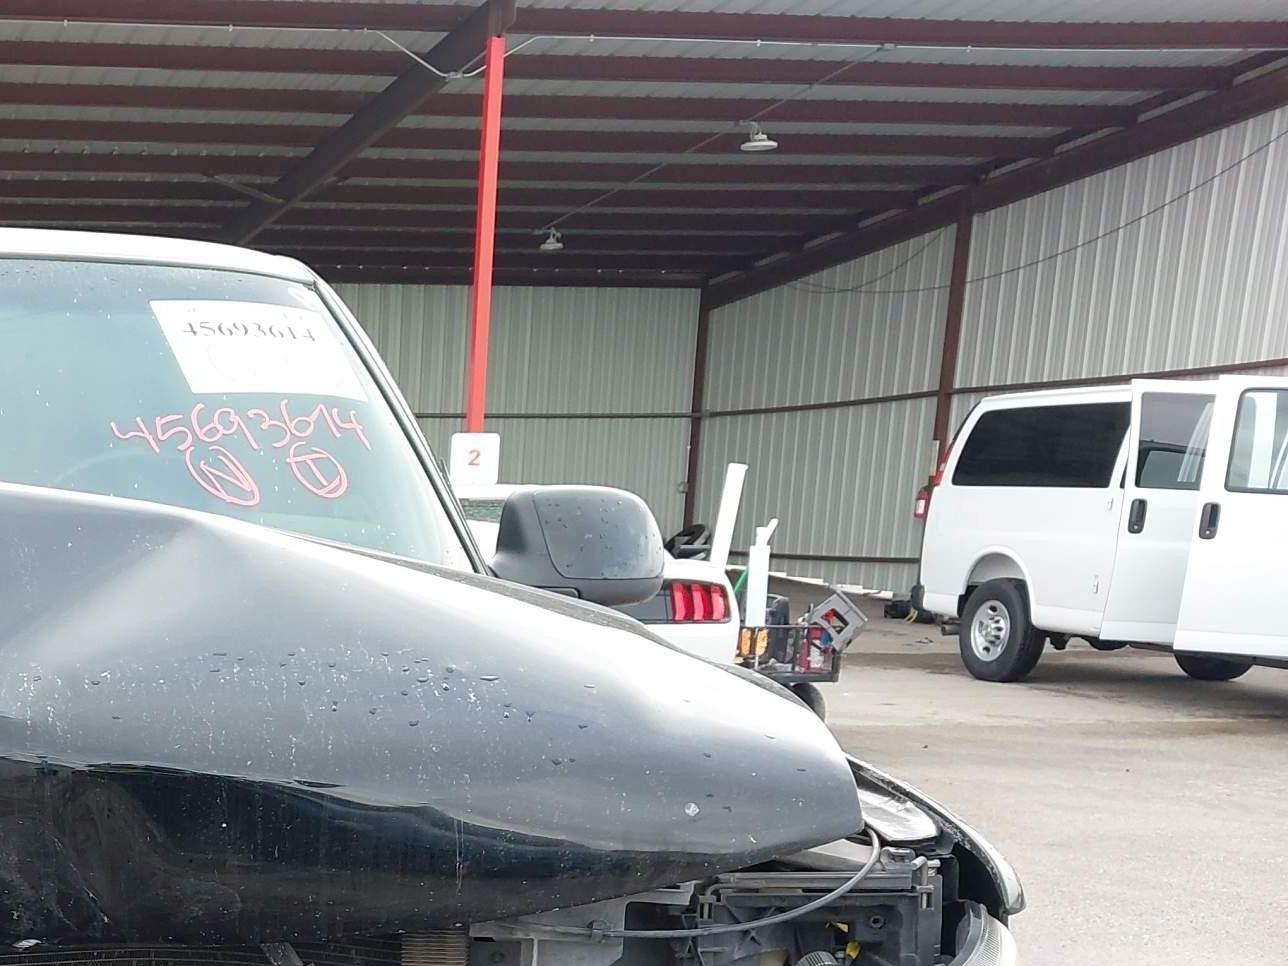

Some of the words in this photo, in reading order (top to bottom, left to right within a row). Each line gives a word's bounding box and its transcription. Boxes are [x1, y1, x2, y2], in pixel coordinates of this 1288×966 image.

[182, 320, 316, 342] 45693614
[110, 399, 372, 453] 45693614
[467, 448, 481, 466] 2
